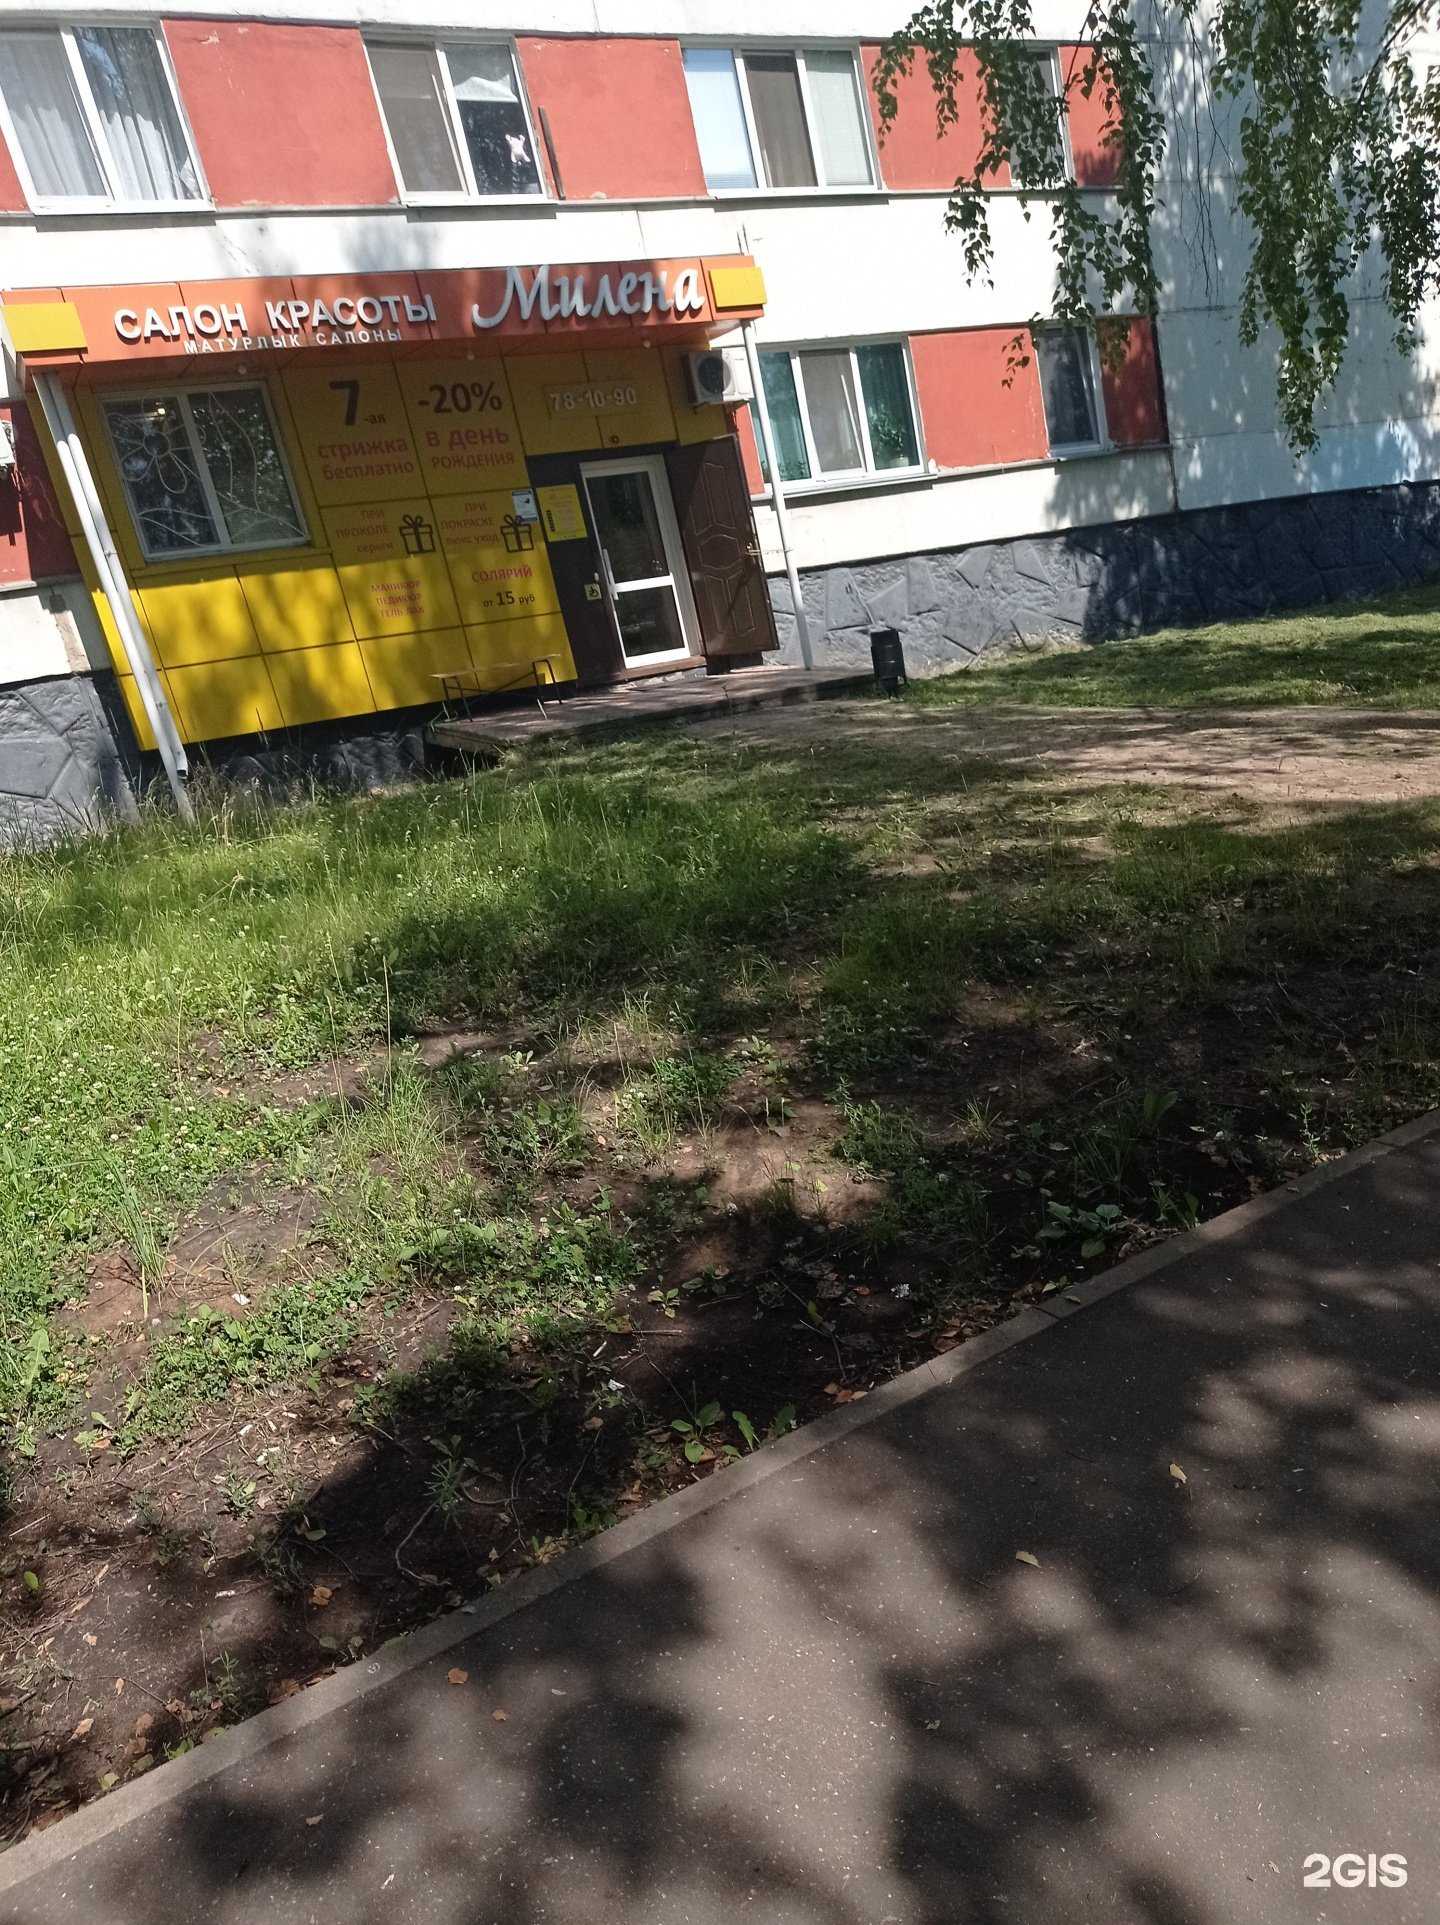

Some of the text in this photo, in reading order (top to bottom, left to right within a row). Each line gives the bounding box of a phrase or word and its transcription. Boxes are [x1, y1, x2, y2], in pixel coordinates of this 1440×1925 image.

[472, 264, 706, 329] Милена
[113, 294, 437, 340] САЛОН КРАСОТЫ
[184, 329, 402, 354] МАТУРЛЫК САЛОНЫ
[417, 381, 503, 414] -20%
[550, 387, 638, 411] 78-10-90
[318, 437, 409, 462] стрижка
[449, 427, 510, 450] день
[323, 460, 415, 480] бесплатно
[432, 452, 515, 470] РОЖДЕНИЯ
[471, 564, 533, 583] СОЛЯРИЙ
[496, 591, 516, 606] 15
